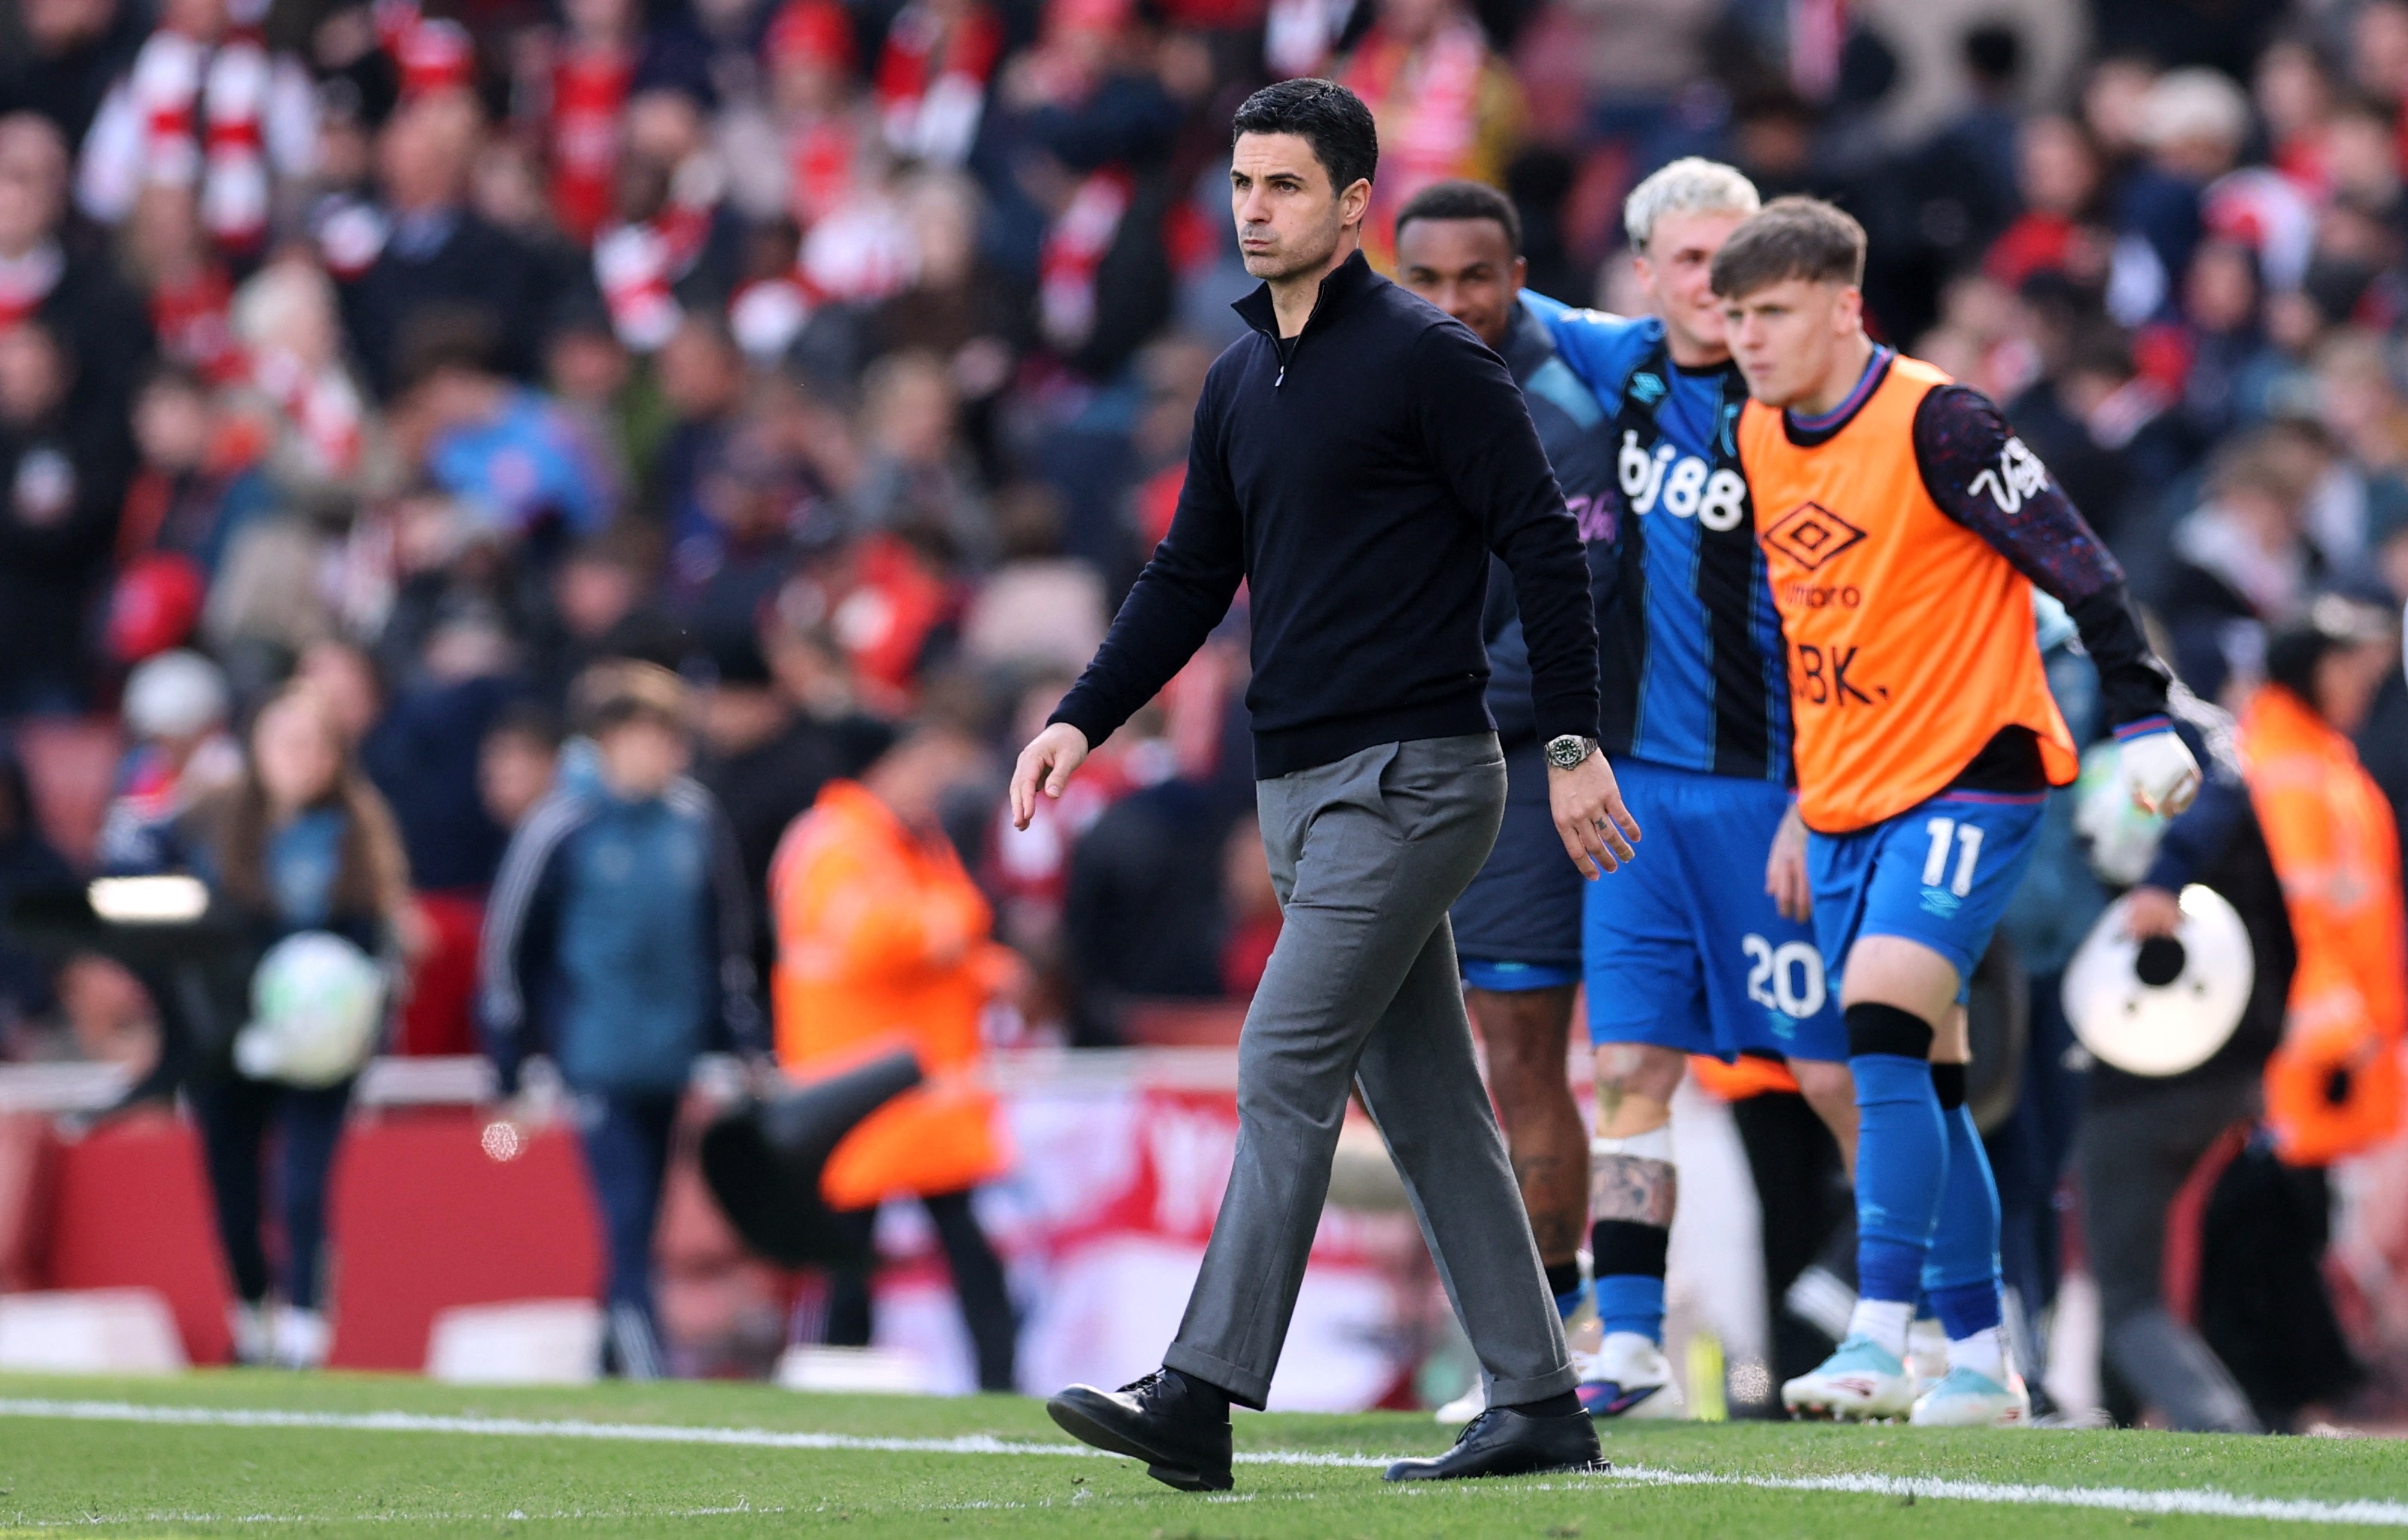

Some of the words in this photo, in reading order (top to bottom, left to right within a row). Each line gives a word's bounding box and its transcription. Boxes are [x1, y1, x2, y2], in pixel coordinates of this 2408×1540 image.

[1619, 429, 1747, 531] bj88
[1790, 644, 1888, 707] BK.
[1921, 817, 1984, 898] 11
[1742, 933, 1826, 1018] 20
